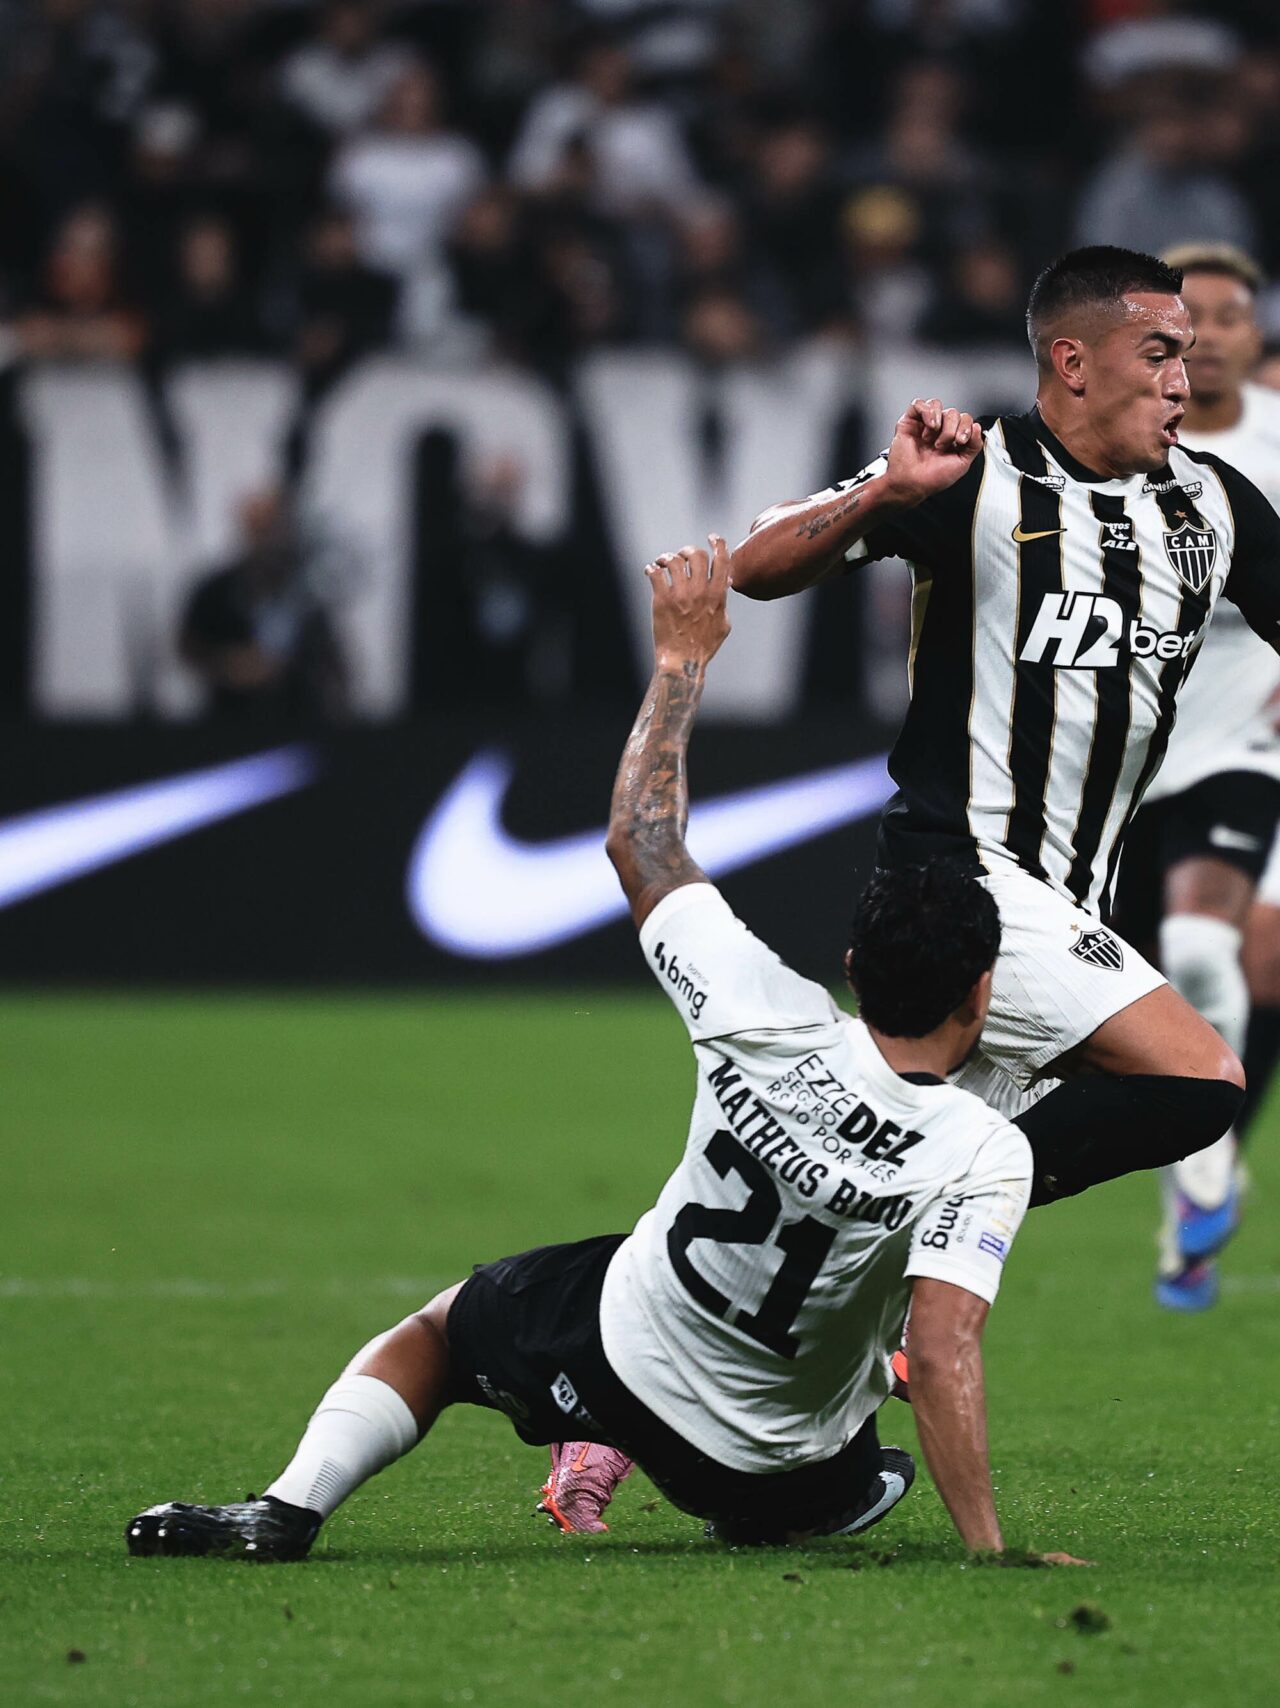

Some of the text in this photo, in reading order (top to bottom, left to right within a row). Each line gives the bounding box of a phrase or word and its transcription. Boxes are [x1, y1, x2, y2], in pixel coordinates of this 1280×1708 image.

[1170, 534, 1210, 549] CAM
[1078, 931, 1108, 953] CAM
[667, 955, 709, 1021] bmg
[707, 1056, 829, 1198] MATHEUS
[812, 1126, 852, 1165] POR
[835, 1101, 927, 1169] DEZ
[666, 1129, 839, 1361] 21
